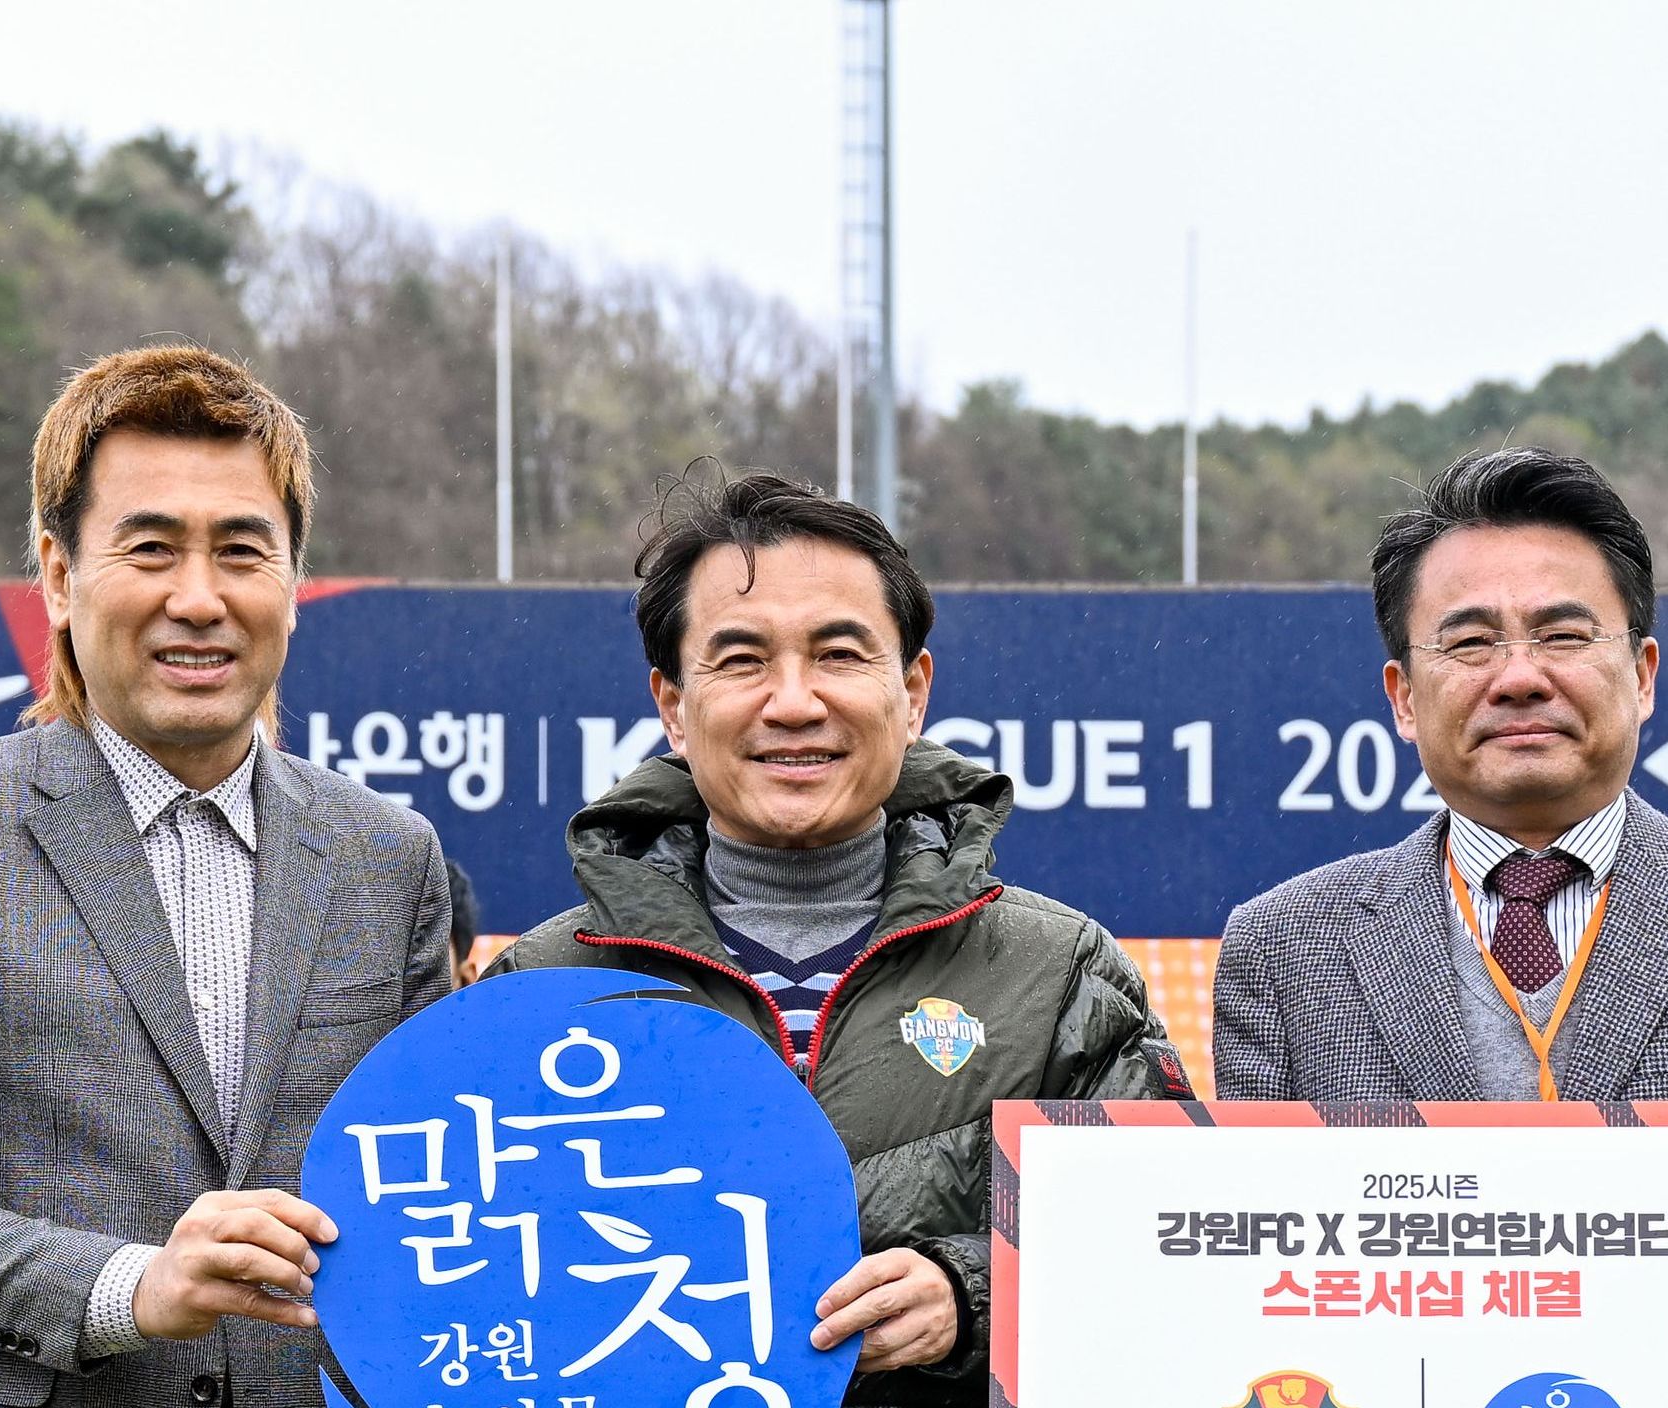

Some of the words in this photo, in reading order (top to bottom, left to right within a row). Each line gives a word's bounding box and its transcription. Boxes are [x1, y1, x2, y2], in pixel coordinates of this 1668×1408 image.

[1172, 720, 1213, 809] 1
[899, 1017, 986, 1047] GANGWON
[933, 1038, 955, 1053] FC
[1363, 1173, 1479, 1200] 2025시즌
[1157, 1211, 1306, 1257] 강원FC
[1316, 1212, 1345, 1256] X
[1262, 1270, 1464, 1317] 스폰서십
[1482, 1270, 1582, 1317] 체결
[418, 1318, 539, 1388] 강원
